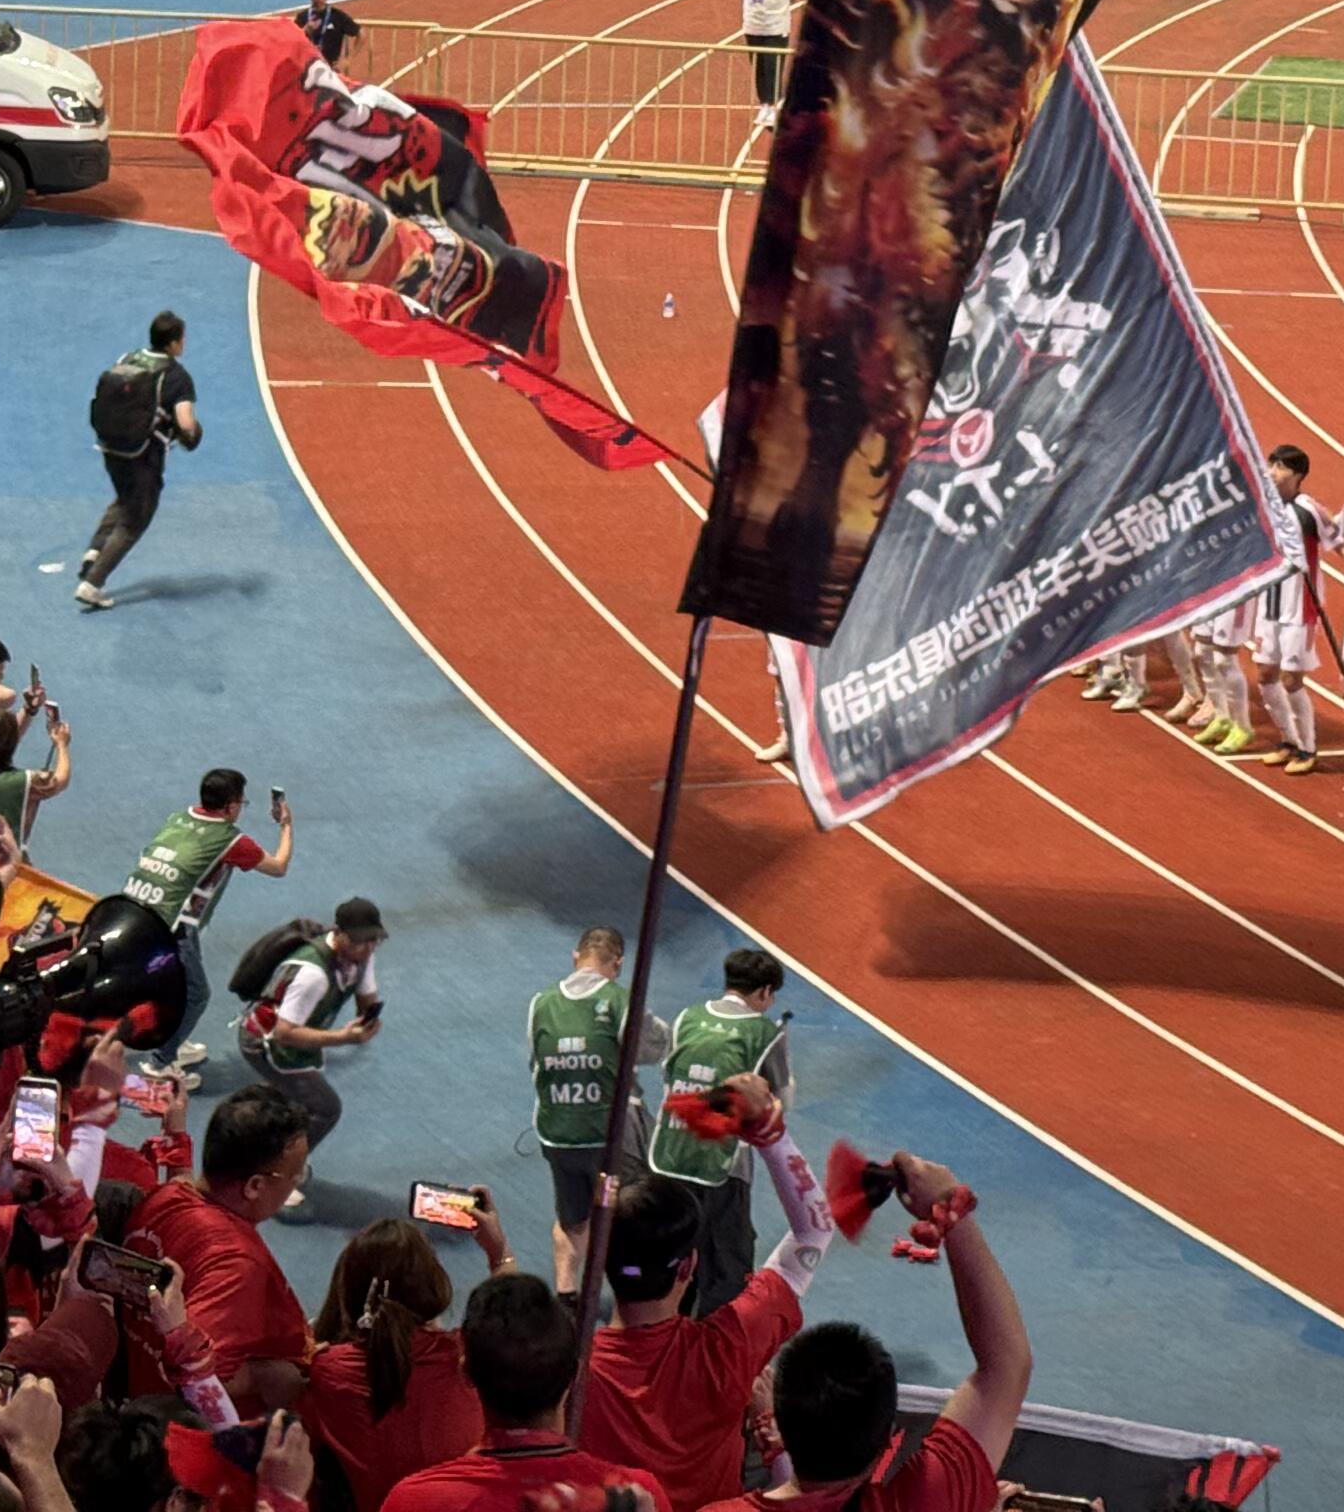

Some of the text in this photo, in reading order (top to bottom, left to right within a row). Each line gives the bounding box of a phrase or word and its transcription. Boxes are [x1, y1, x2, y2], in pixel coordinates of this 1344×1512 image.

[123, 876, 164, 904] M09
[544, 1054, 603, 1070] PHOTO
[550, 1082, 601, 1104] M20
